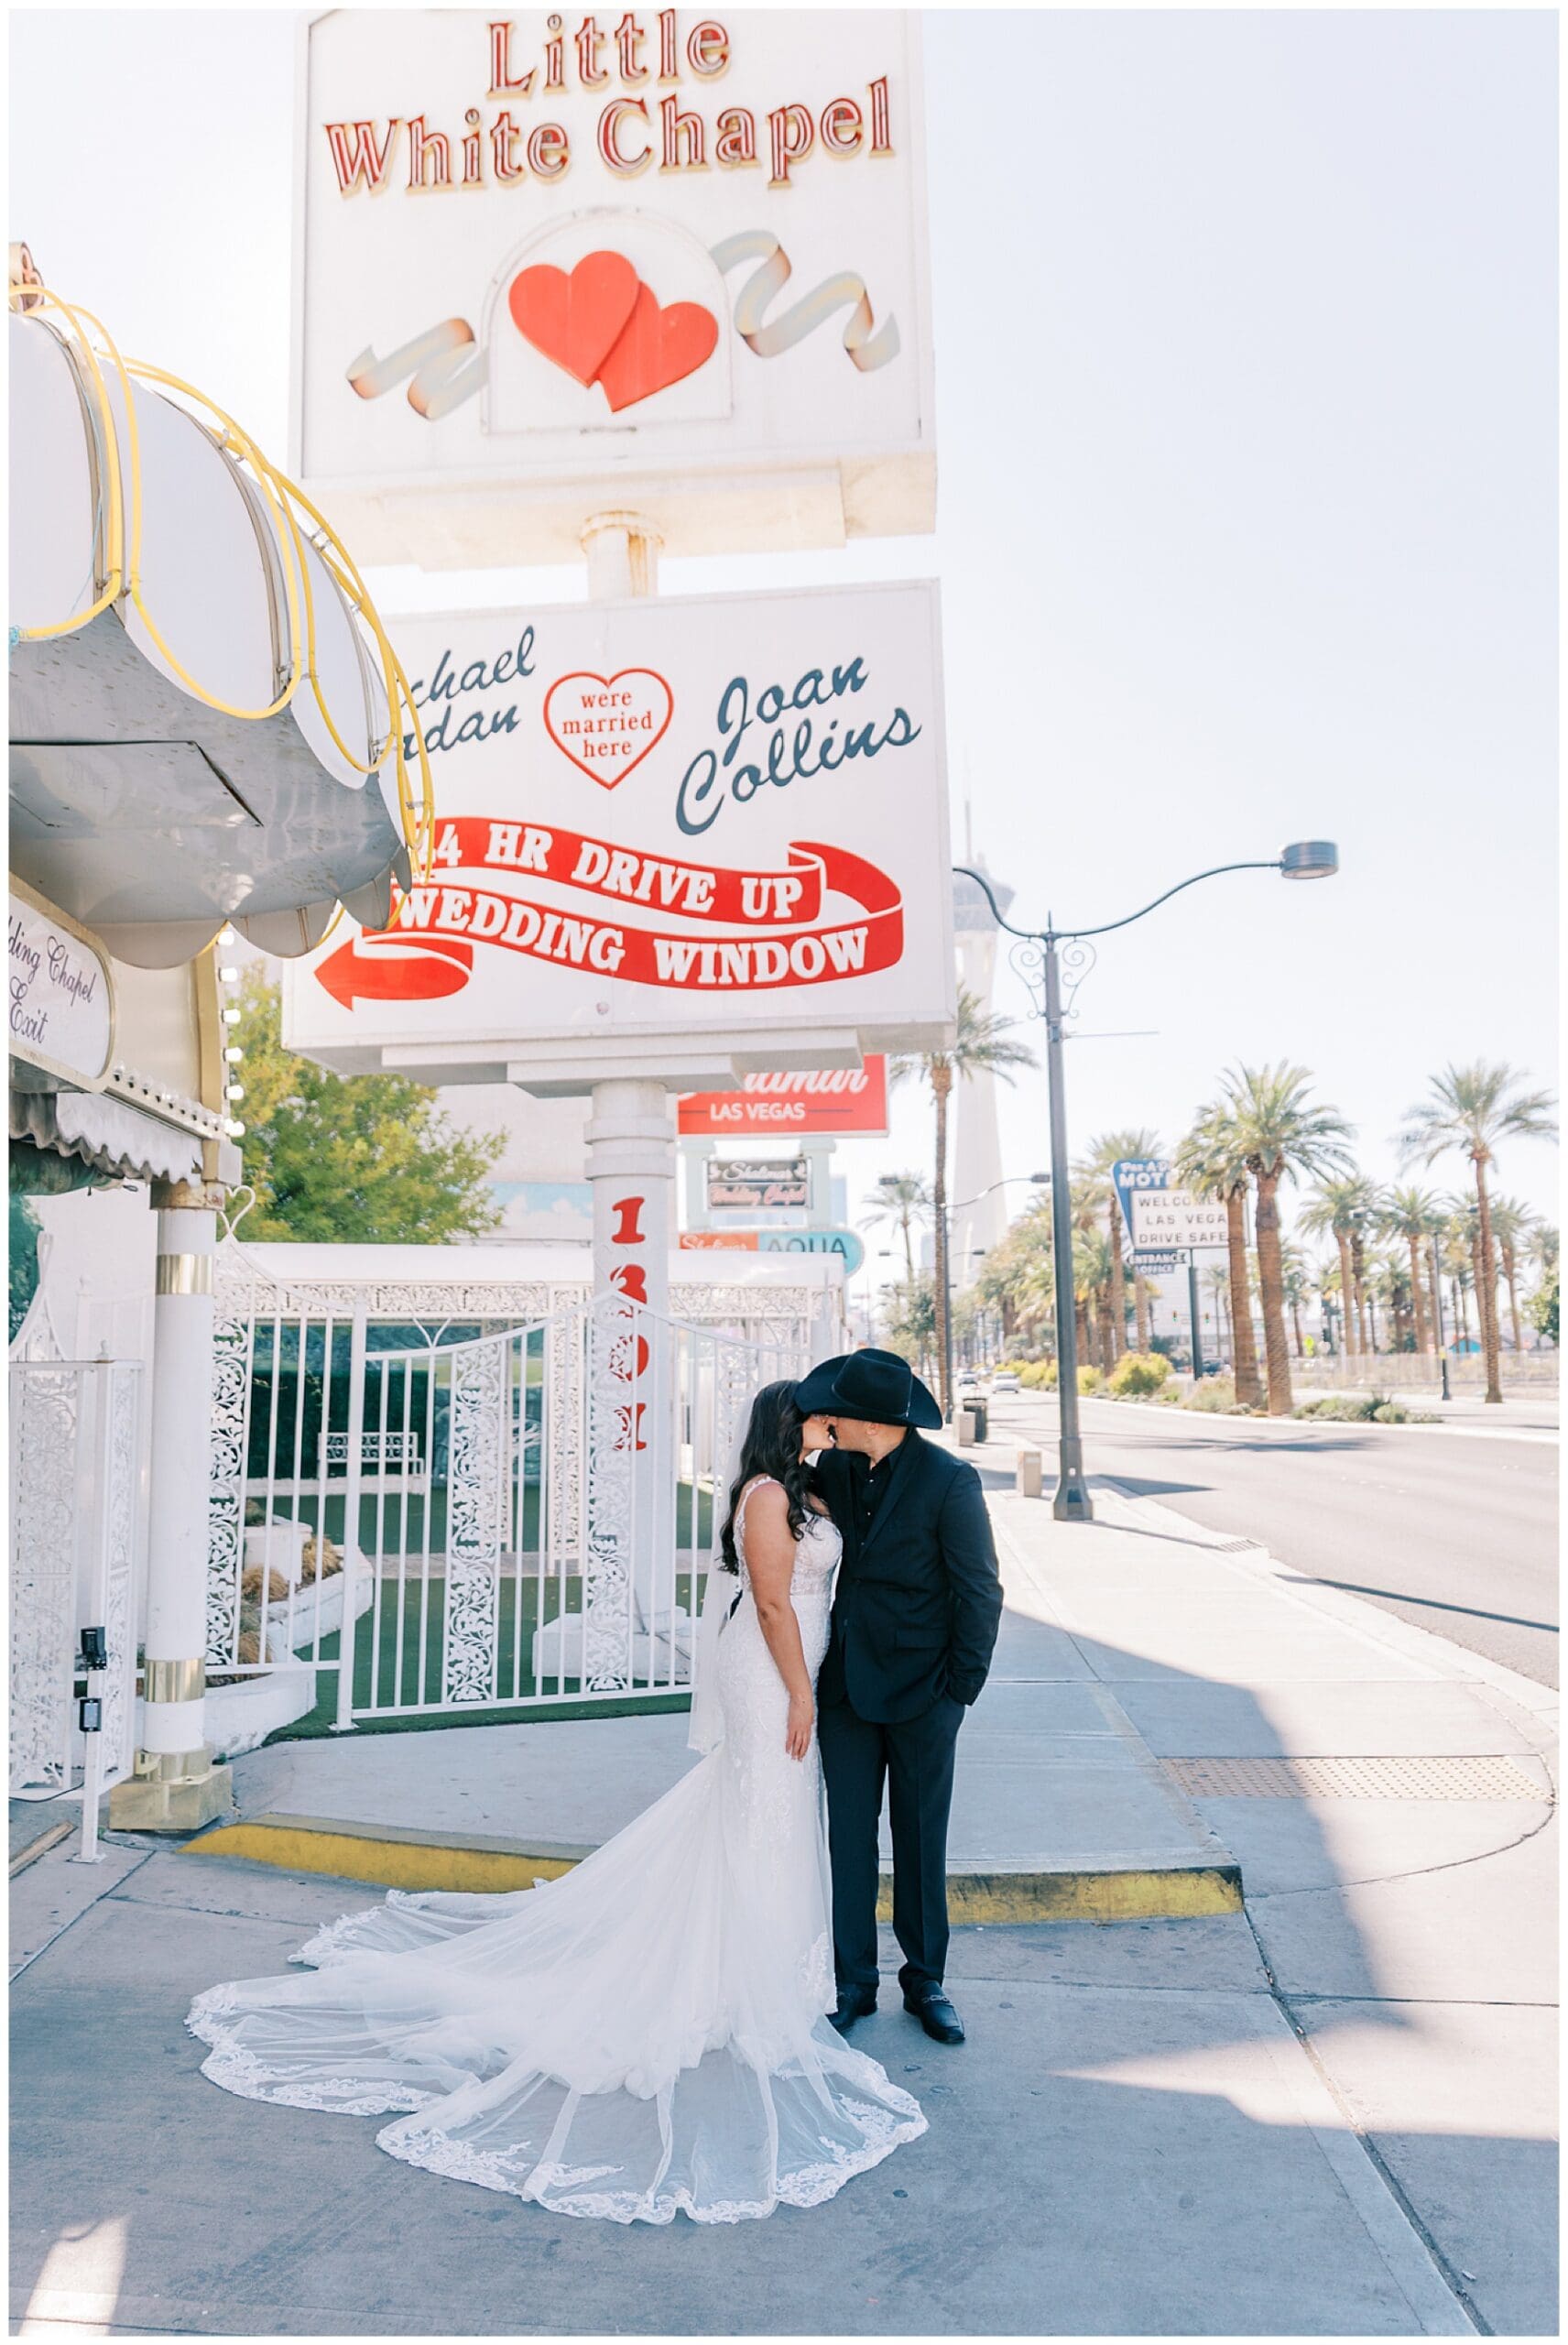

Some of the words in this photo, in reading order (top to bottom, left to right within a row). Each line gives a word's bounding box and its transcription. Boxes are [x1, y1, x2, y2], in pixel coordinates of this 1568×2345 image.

[485, 8, 731, 97] Little
[323, 108, 570, 196] White
[596, 76, 895, 188] Chapel
[400, 625, 536, 709] chael
[581, 692, 633, 709] were
[403, 704, 520, 761] rdan
[561, 711, 653, 735] married
[717, 656, 870, 768] Joan
[583, 739, 632, 758] here
[675, 707, 923, 835] Collins
[485, 823, 553, 872] HR
[571, 841, 717, 913] DRIVE
[740, 877, 803, 919] UP
[8, 915, 41, 985] ding
[47, 935, 97, 1008] Chapel
[393, 888, 626, 972] WEDDING
[652, 926, 869, 985] WINDOW
[9, 976, 49, 1044] Exit
[710, 1102, 743, 1122] LAS
[746, 1102, 807, 1121] VEGAS
[1138, 1194, 1215, 1207] WELCOE
[1145, 1214, 1176, 1226] LAS
[1186, 1213, 1226, 1225] VEGA
[1139, 1233, 1183, 1244] DRIVE
